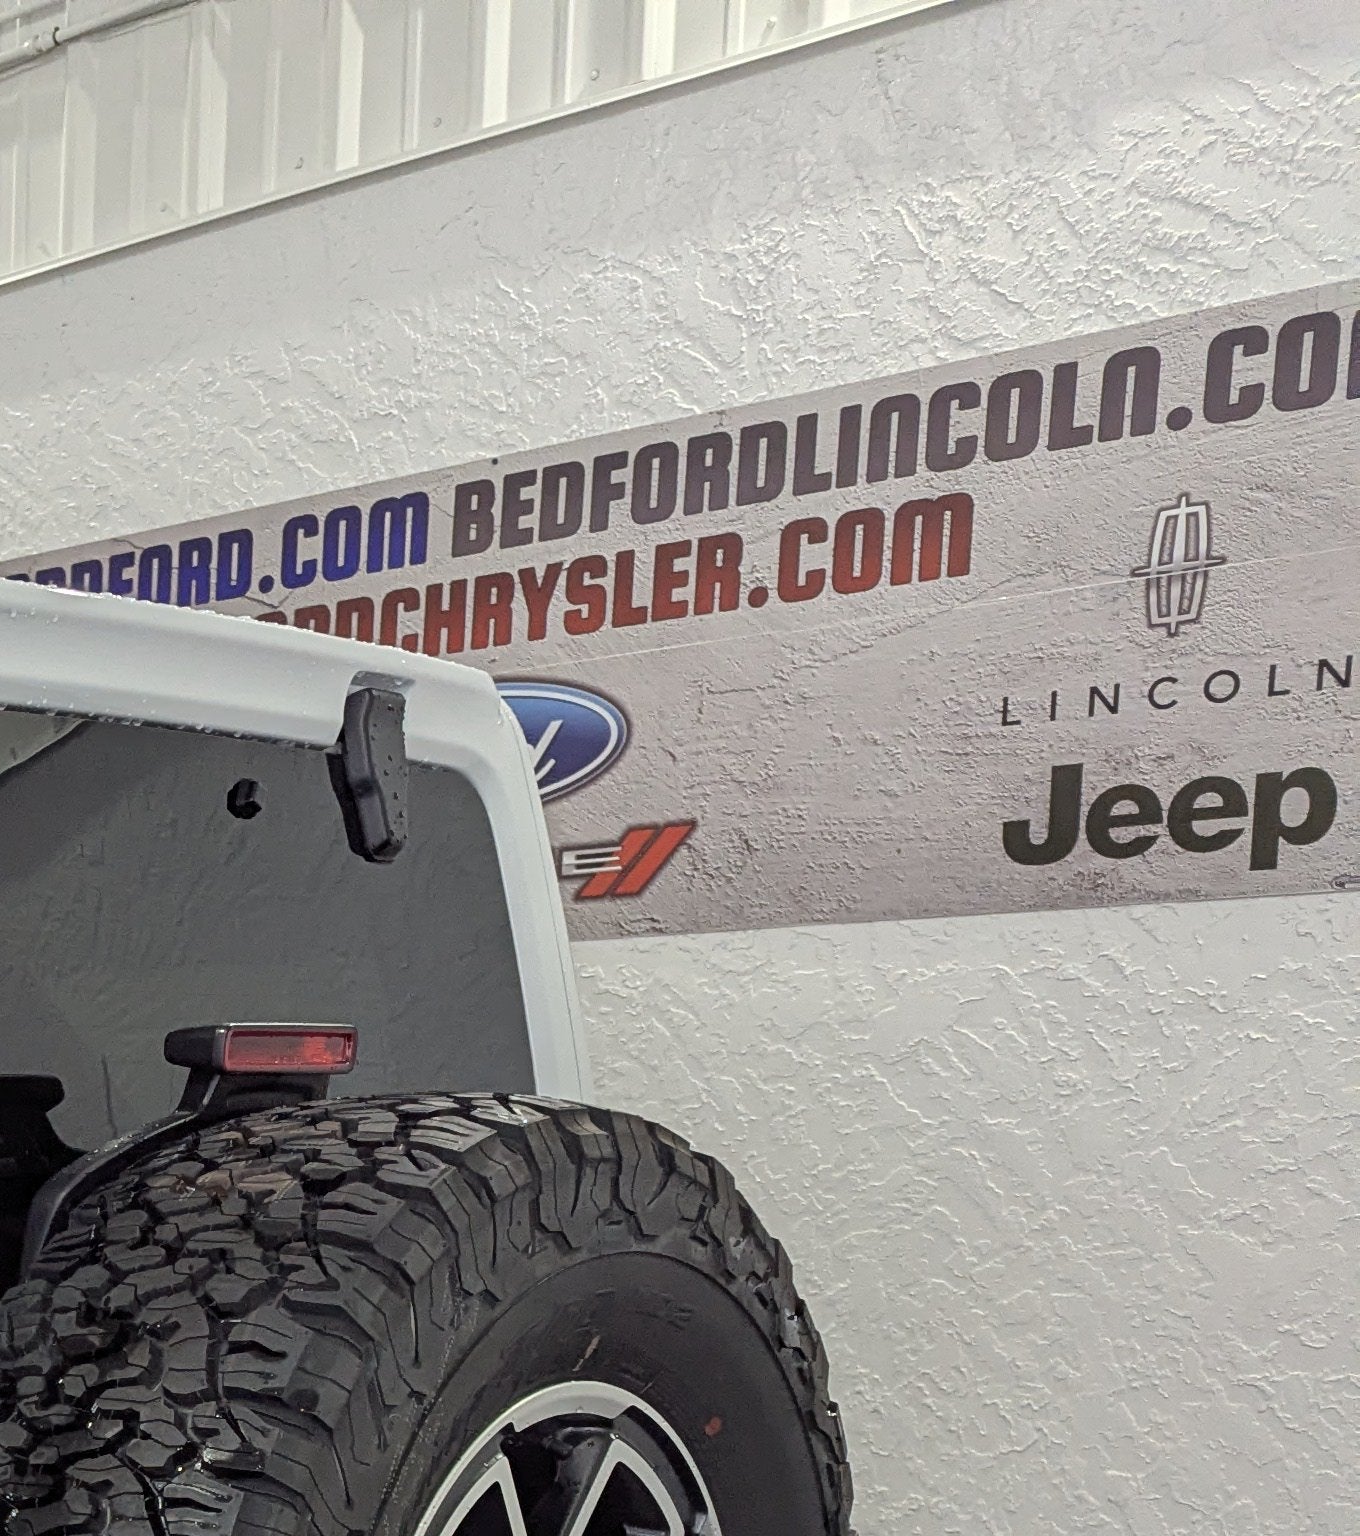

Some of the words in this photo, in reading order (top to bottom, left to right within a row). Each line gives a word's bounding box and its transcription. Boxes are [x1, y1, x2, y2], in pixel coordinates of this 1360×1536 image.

[5, 489, 430, 607] FORD.COM
[451, 310, 1360, 557] BEDFORDLINCOLN.CO
[254, 492, 974, 656] DCHRYSLER.COM
[1001, 655, 1353, 727] LINCOLN
[1002, 762, 1338, 871] Jeep
